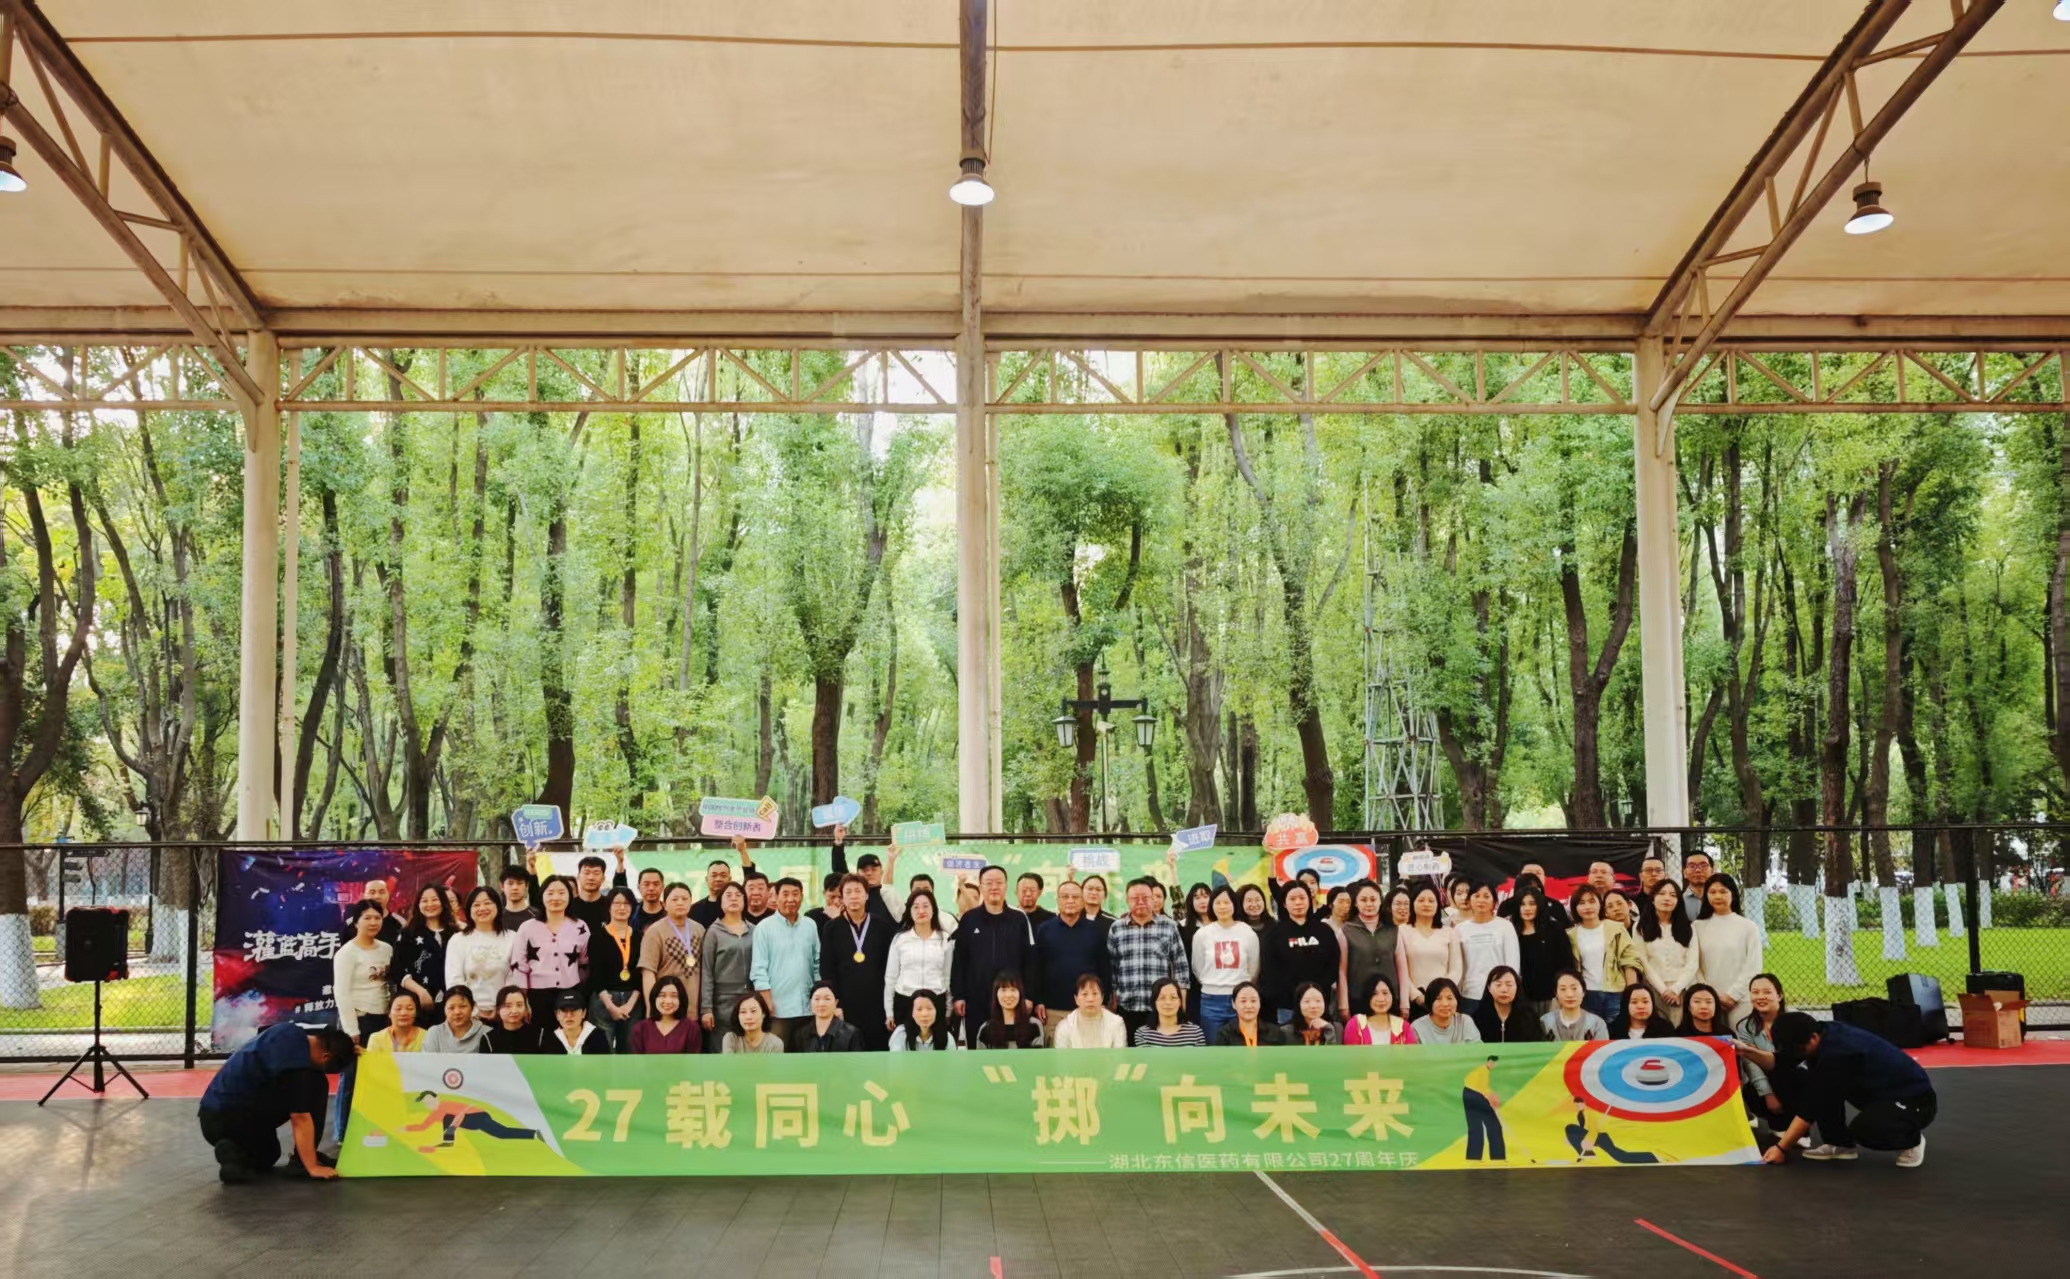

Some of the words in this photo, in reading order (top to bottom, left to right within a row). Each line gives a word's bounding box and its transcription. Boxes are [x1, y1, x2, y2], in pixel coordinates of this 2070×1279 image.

[519, 820, 548, 838] 创新
[1288, 936, 1320, 948] FILA
[562, 1080, 911, 1149] 27载同心
[1109, 1152, 1418, 1170] 湖北东信医药有限公司27周年庆
